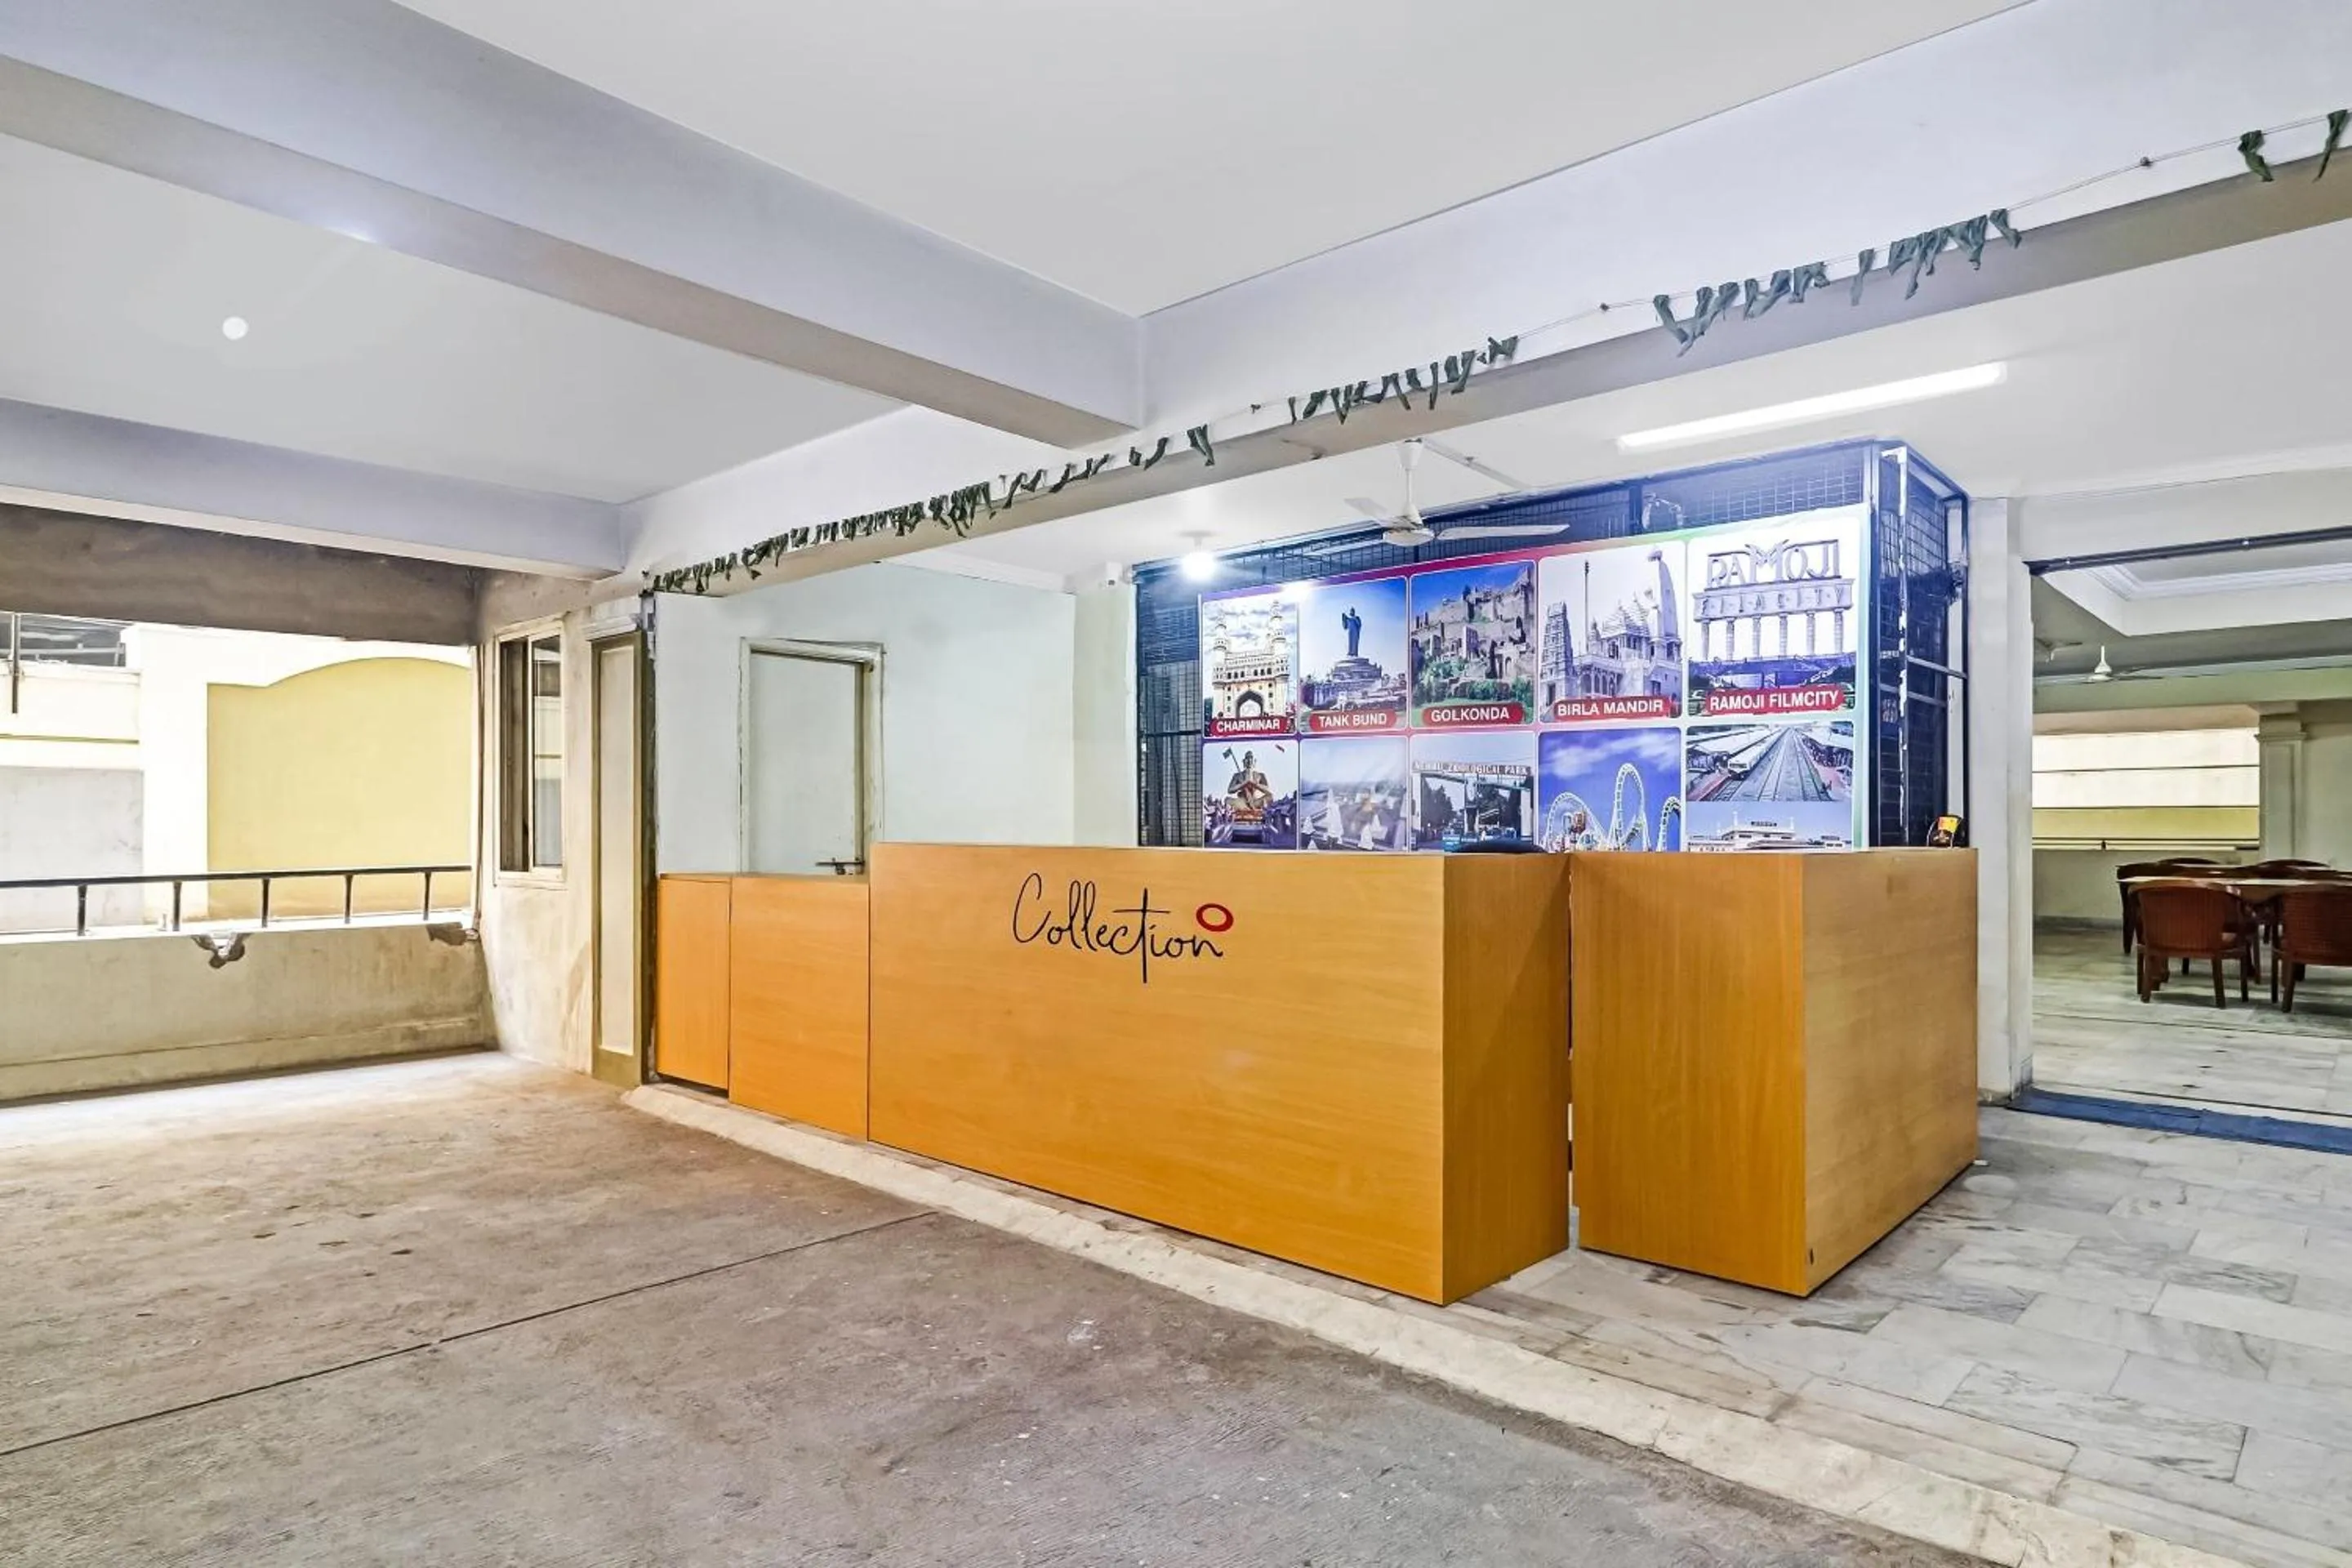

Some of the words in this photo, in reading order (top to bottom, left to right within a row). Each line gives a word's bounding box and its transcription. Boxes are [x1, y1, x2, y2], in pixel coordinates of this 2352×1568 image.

[1557, 703, 1599, 716] BIRLA
[1603, 699, 1664, 713] MANDIR
[1710, 696, 1765, 710] RAMOJI
[1770, 691, 1838, 707] FILMCITY
[1318, 714, 1348, 727] TANK
[1352, 712, 1387, 725] BUND
[1431, 707, 1510, 722] GOLKONDA
[1216, 719, 1280, 733] CHARMINAR
[1013, 872, 1223, 983] Collection
